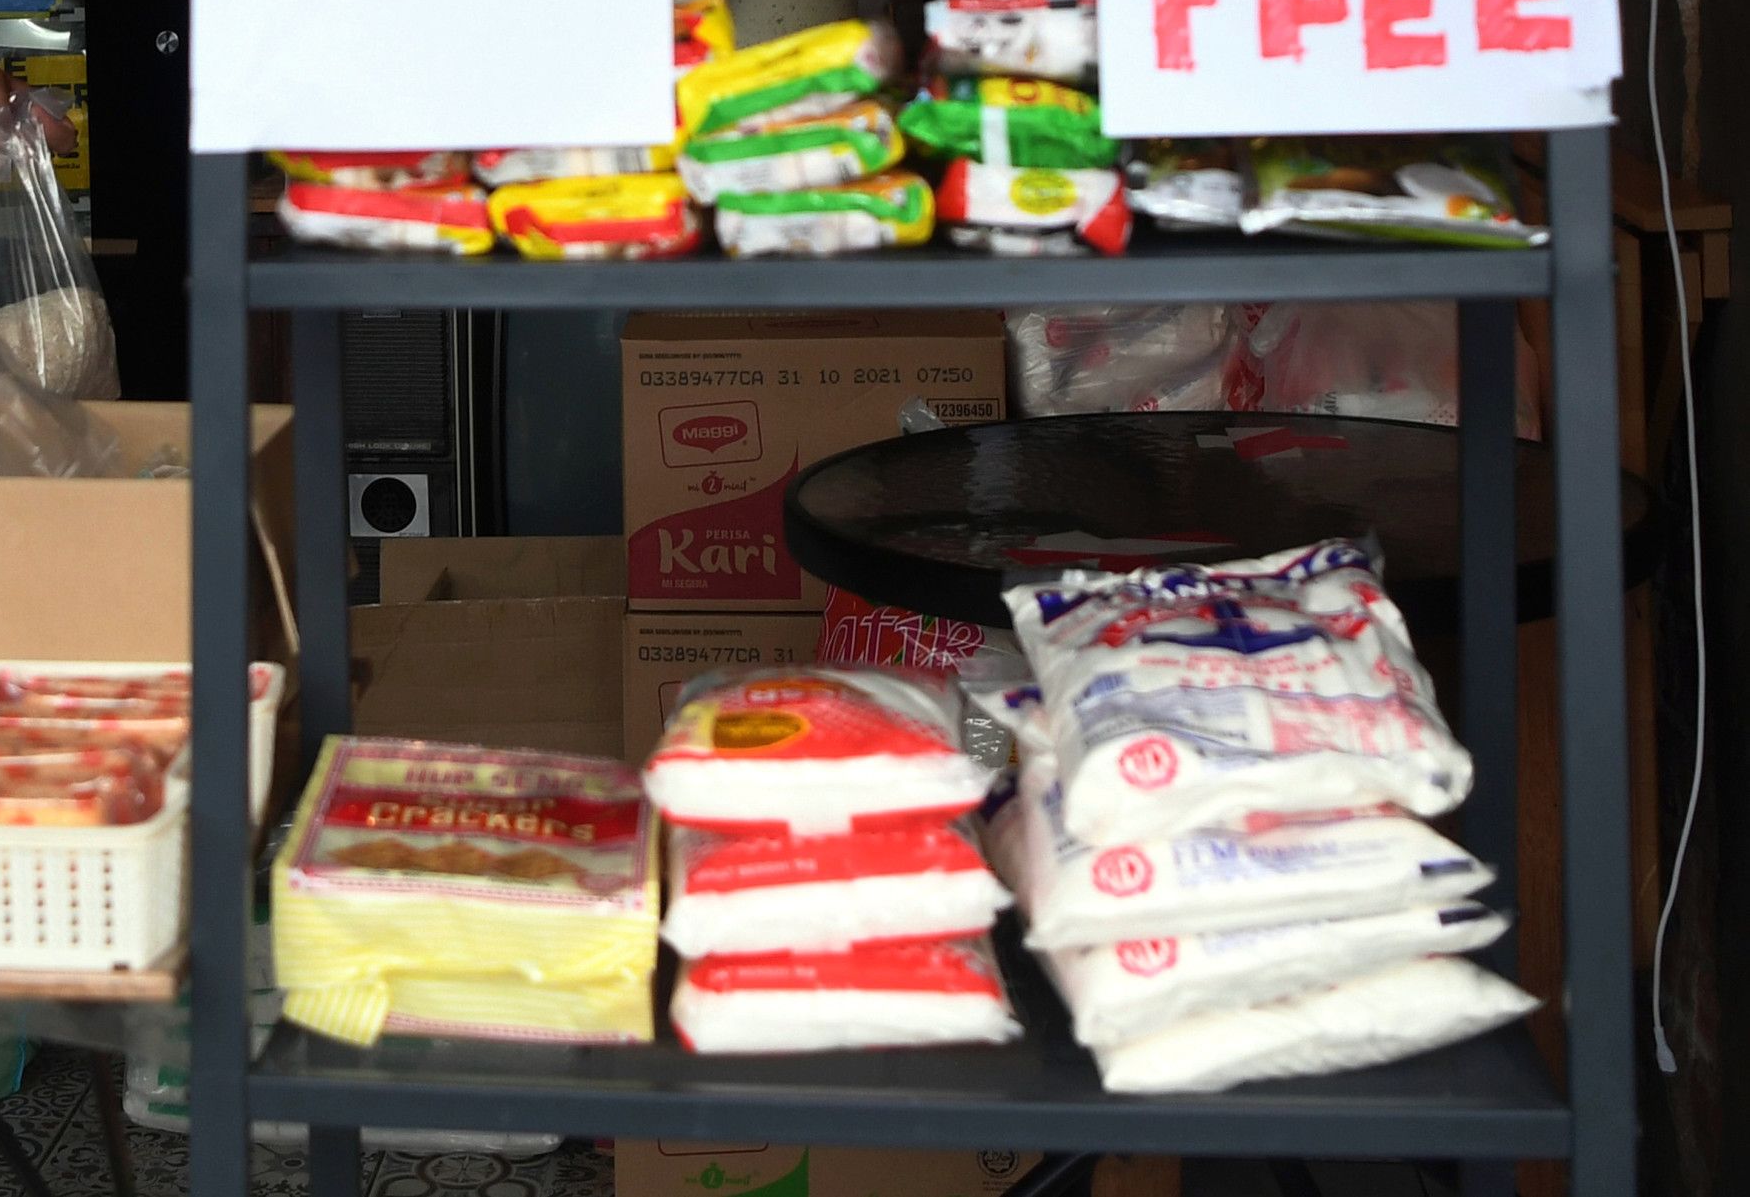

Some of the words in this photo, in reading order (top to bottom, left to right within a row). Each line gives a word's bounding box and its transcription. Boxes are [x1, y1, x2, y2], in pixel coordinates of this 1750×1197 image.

[777, 370, 801, 385] 31
[819, 369, 840, 384] 10
[854, 368, 901, 383] 2021
[917, 367, 973, 383] 07:50
[935, 404, 993, 418] 12396450
[705, 529, 751, 540] PERISA
[658, 528, 777, 576] Kari
[774, 648, 794, 662] 31
[370, 801, 596, 841] Crackers
